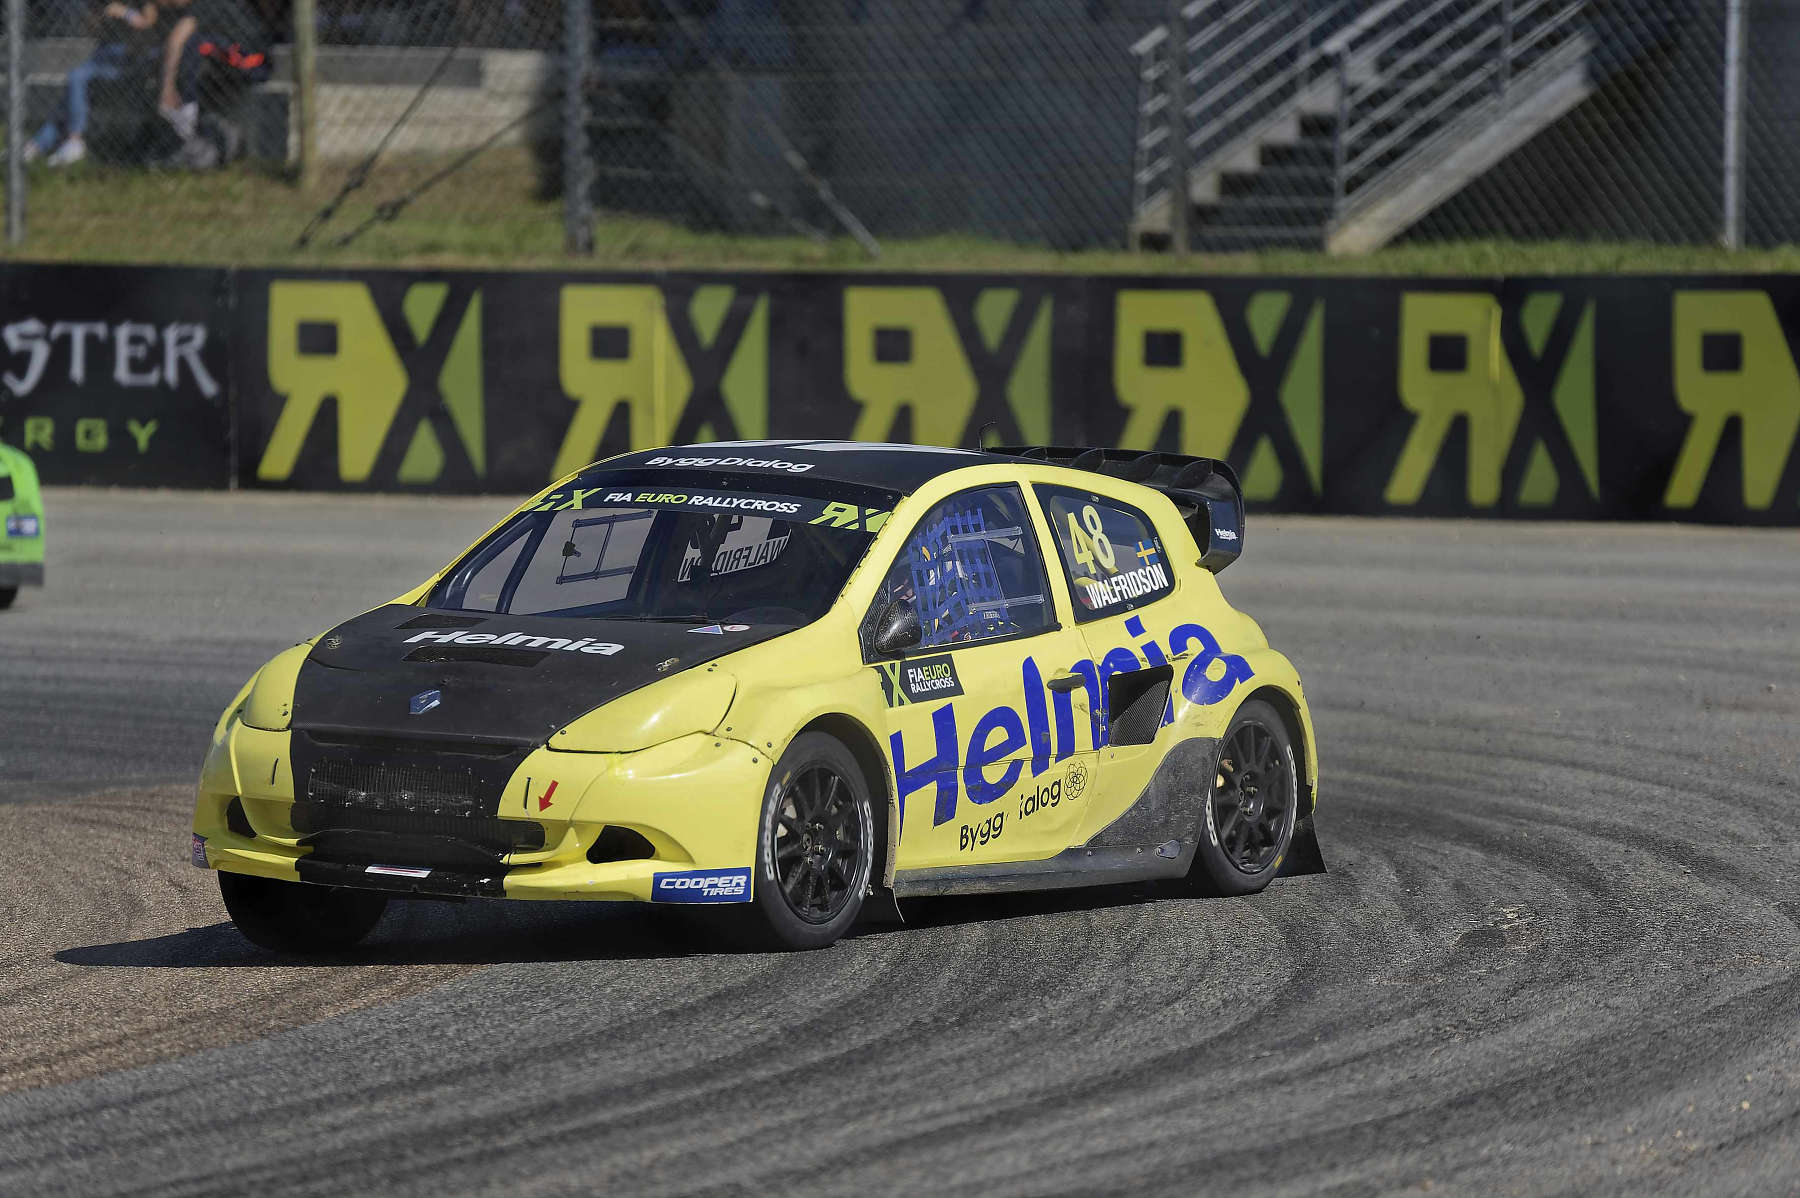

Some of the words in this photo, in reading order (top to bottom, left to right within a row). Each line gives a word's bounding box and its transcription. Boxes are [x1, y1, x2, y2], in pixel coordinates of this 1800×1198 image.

[1664, 290, 1800, 509] R
[0, 416, 158, 453] RGY
[603, 492, 633, 503] FIA
[634, 493, 688, 505] EURO
[688, 495, 802, 514] RALLYCROSS
[1067, 505, 1116, 575] 48
[1086, 563, 1169, 609] WALFRIDSON
[403, 631, 625, 656] Helmia
[910, 677, 955, 694] RALLYCROSS
[660, 875, 748, 889] COOPER
[702, 886, 746, 896] TIRES
